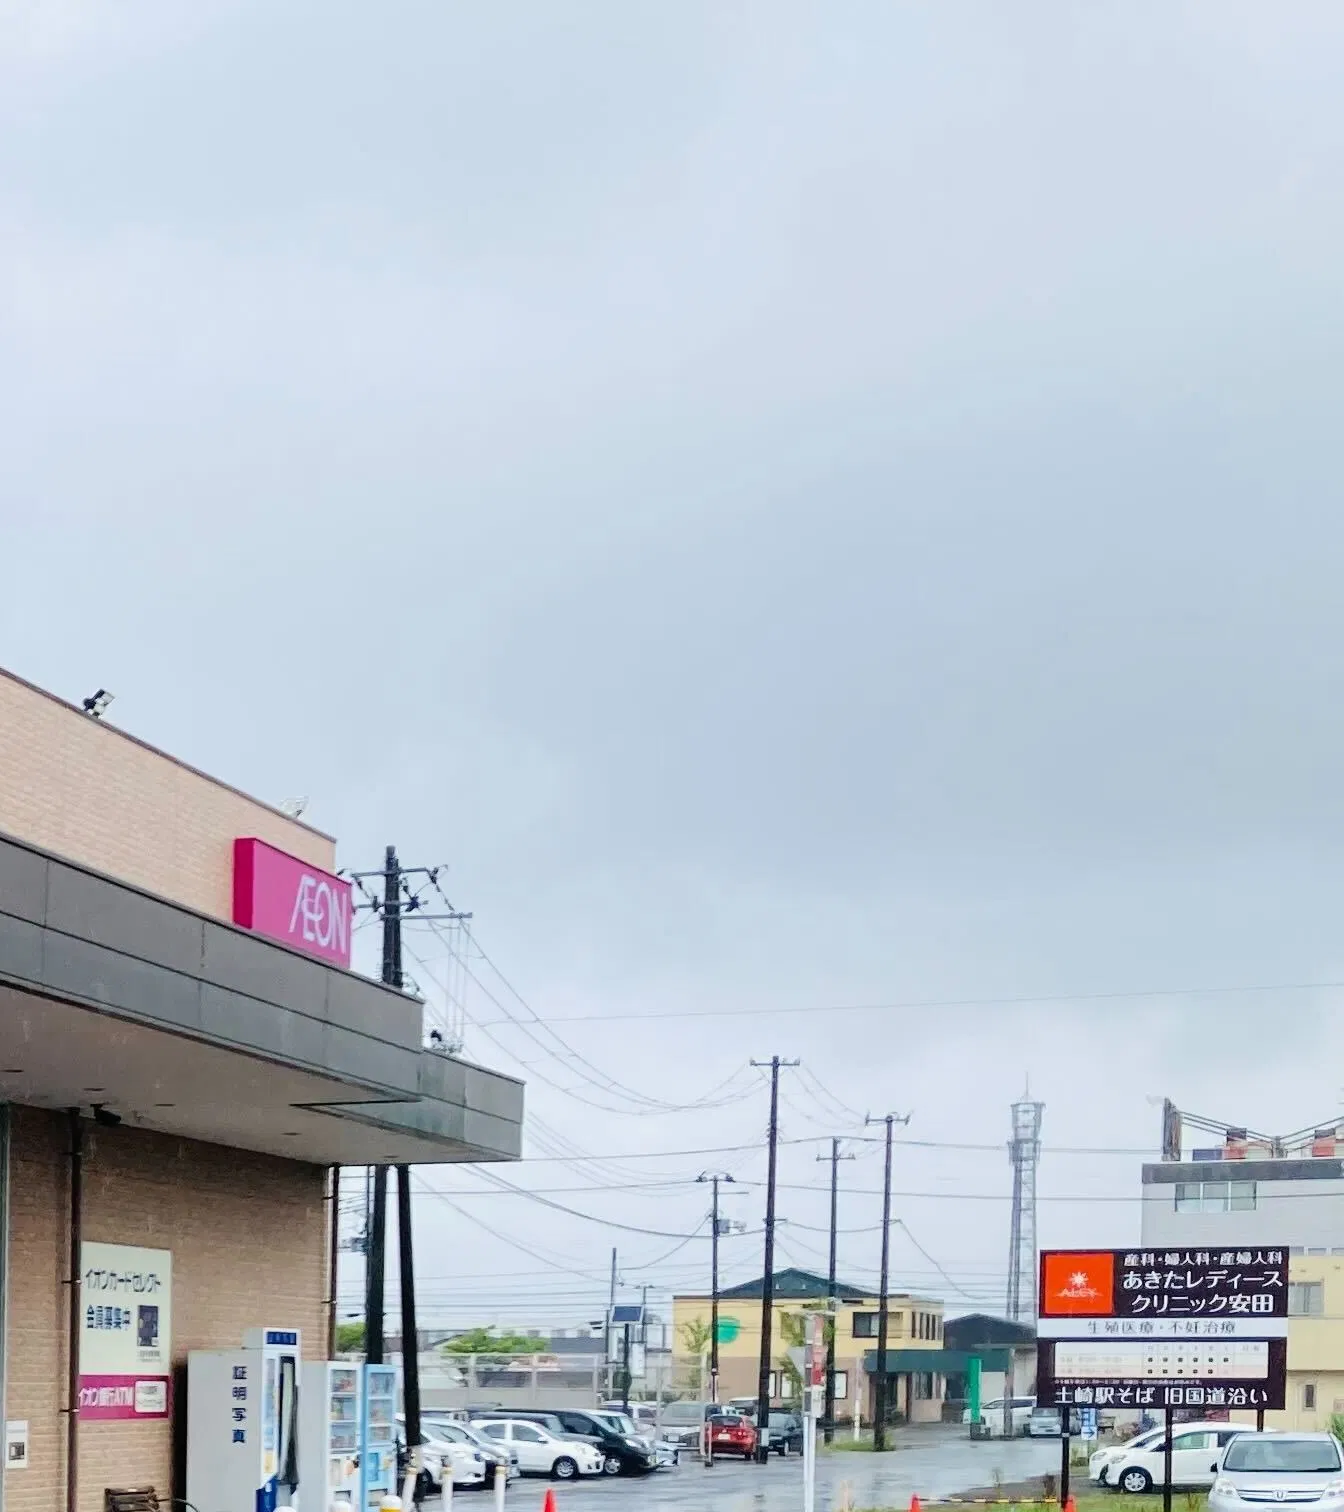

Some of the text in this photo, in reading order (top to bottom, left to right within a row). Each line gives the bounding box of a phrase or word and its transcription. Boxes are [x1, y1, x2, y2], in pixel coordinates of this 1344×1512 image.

[1122, 1270, 1284, 1290] あきたレディース
[1131, 1293, 1274, 1313] クリニック安田
[1087, 1320, 1236, 1334] 生殖医療・不妊治療
[231, 1365, 248, 1444] 証明写真
[1054, 1386, 1268, 1405] 土崎駅そば 旧国道沿い
